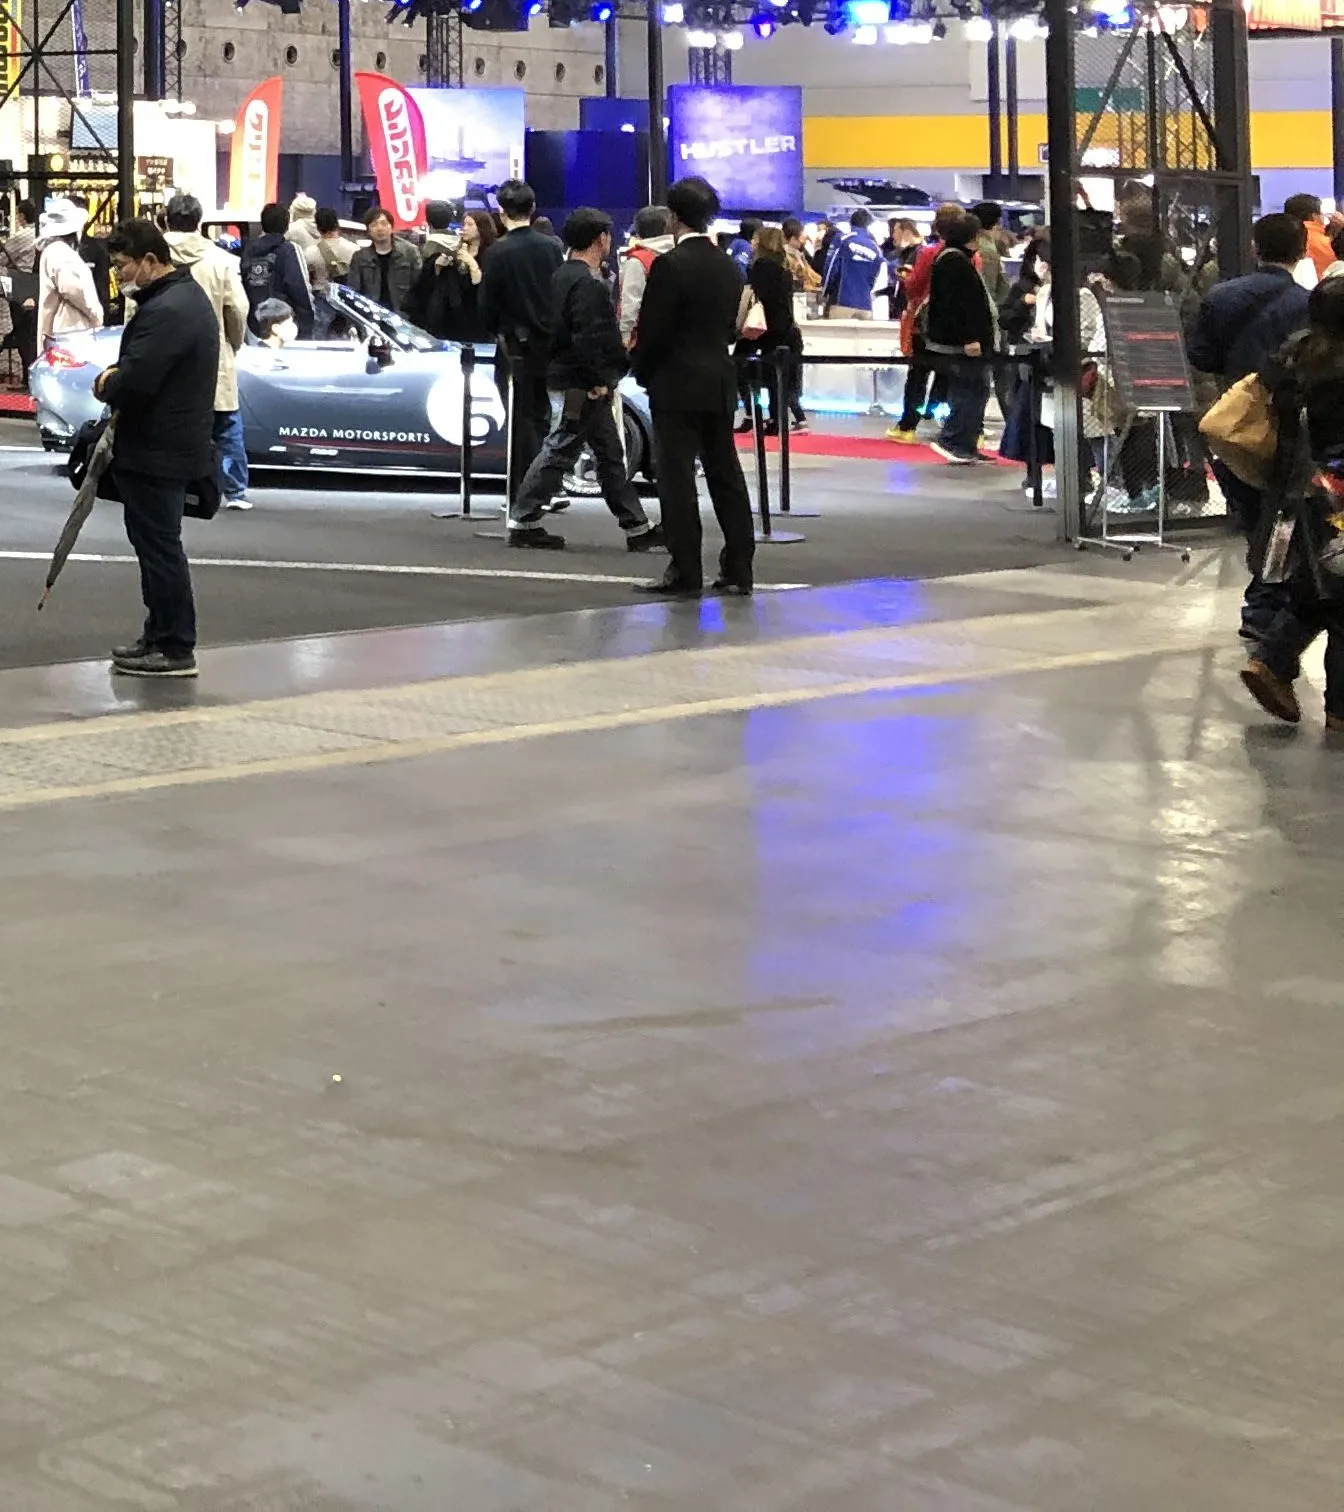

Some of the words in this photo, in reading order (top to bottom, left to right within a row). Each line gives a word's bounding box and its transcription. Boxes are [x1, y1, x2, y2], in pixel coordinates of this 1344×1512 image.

[680, 135, 797, 160] HUSTLER
[278, 426, 328, 439] MAZDA
[332, 429, 431, 443] MOTORSPORTS
